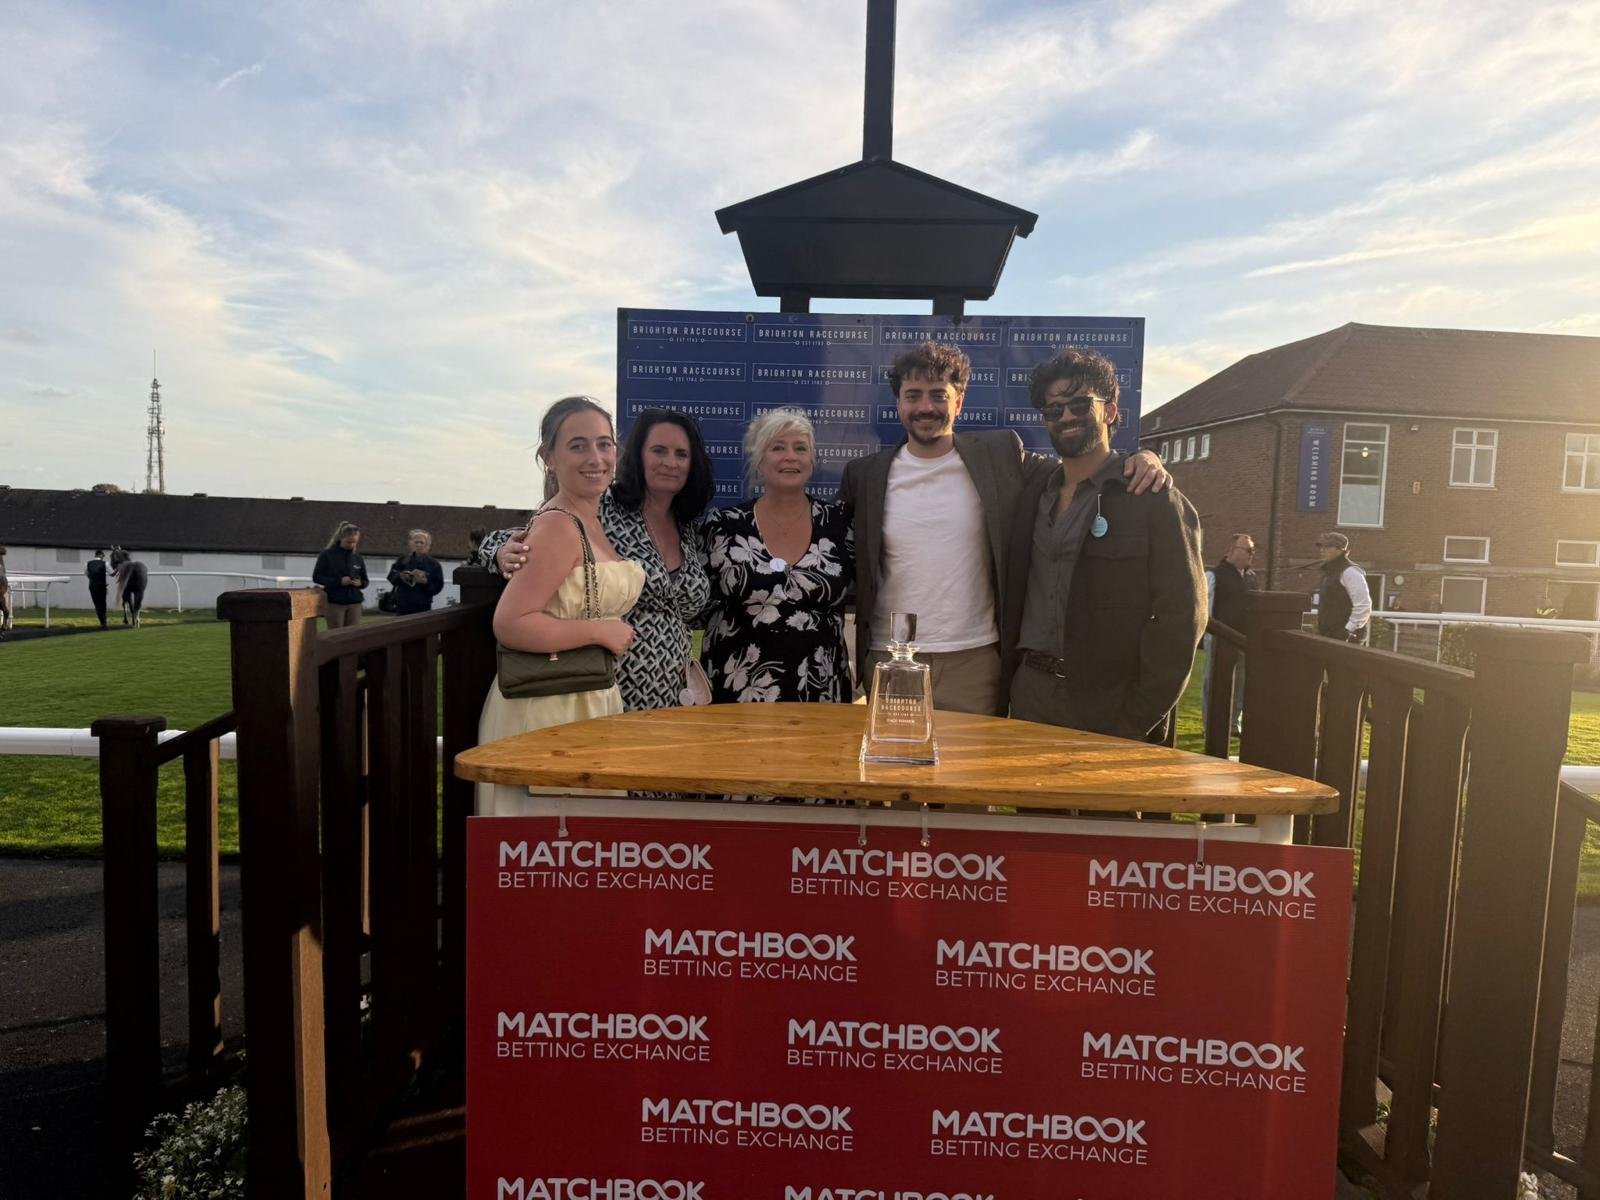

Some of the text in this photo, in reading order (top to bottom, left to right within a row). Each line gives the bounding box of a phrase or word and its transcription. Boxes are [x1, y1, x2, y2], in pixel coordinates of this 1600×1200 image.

[633, 326, 742, 337] BRIGHTON RACECOURSE
[759, 329, 868, 339] BRIGHTON RACECOURSE
[885, 331, 996, 341] BRIGHTON RACECOURSE
[1013, 333, 1127, 342] BRIGHTON RACECOURSE
[632, 365, 741, 376] BRIGHTON RACECOURSE
[757, 368, 866, 379] BRIGHTON RACECOURSE
[807, 409, 865, 418] RACECOURSE
[957, 412, 993, 421] COURSE
[1009, 413, 1044, 422] BRIGHT
[704, 445, 739, 454] COURSE
[815, 448, 864, 457] CECOURSE
[499, 841, 713, 869] MATCHBOOK
[792, 847, 1007, 881] MATCHBOOK
[499, 872, 713, 890] BETTING EXCHANGE
[792, 878, 1007, 902] BETTING EXCHANGE
[1089, 859, 1316, 898] MATCHBOOK
[1088, 891, 1316, 919] BETTING EXCHANGE
[645, 929, 857, 961] MATCHBOOK
[937, 939, 1155, 975] MATCHBOOK
[645, 960, 857, 981] BETTING EXCHANGE
[936, 970, 1155, 996] BETTING EXCHANGE
[498, 1012, 709, 1041] MATCHBOOK
[789, 1019, 1002, 1053] MATCHBOOK
[498, 1042, 709, 1061] BETTING EXCHANGE
[788, 1050, 1002, 1073] BETTING EXCHANGE
[1083, 1032, 1306, 1072] MATCHBOOK
[1082, 1062, 1306, 1092] BETTING EXCHANGE
[642, 1098, 852, 1131] MATCHBOOK
[642, 1127, 852, 1150] BETTING EXCHANGE
[932, 1110, 1147, 1145] MATCHBOOK
[932, 1140, 1147, 1165] BETTING EXCHANGE
